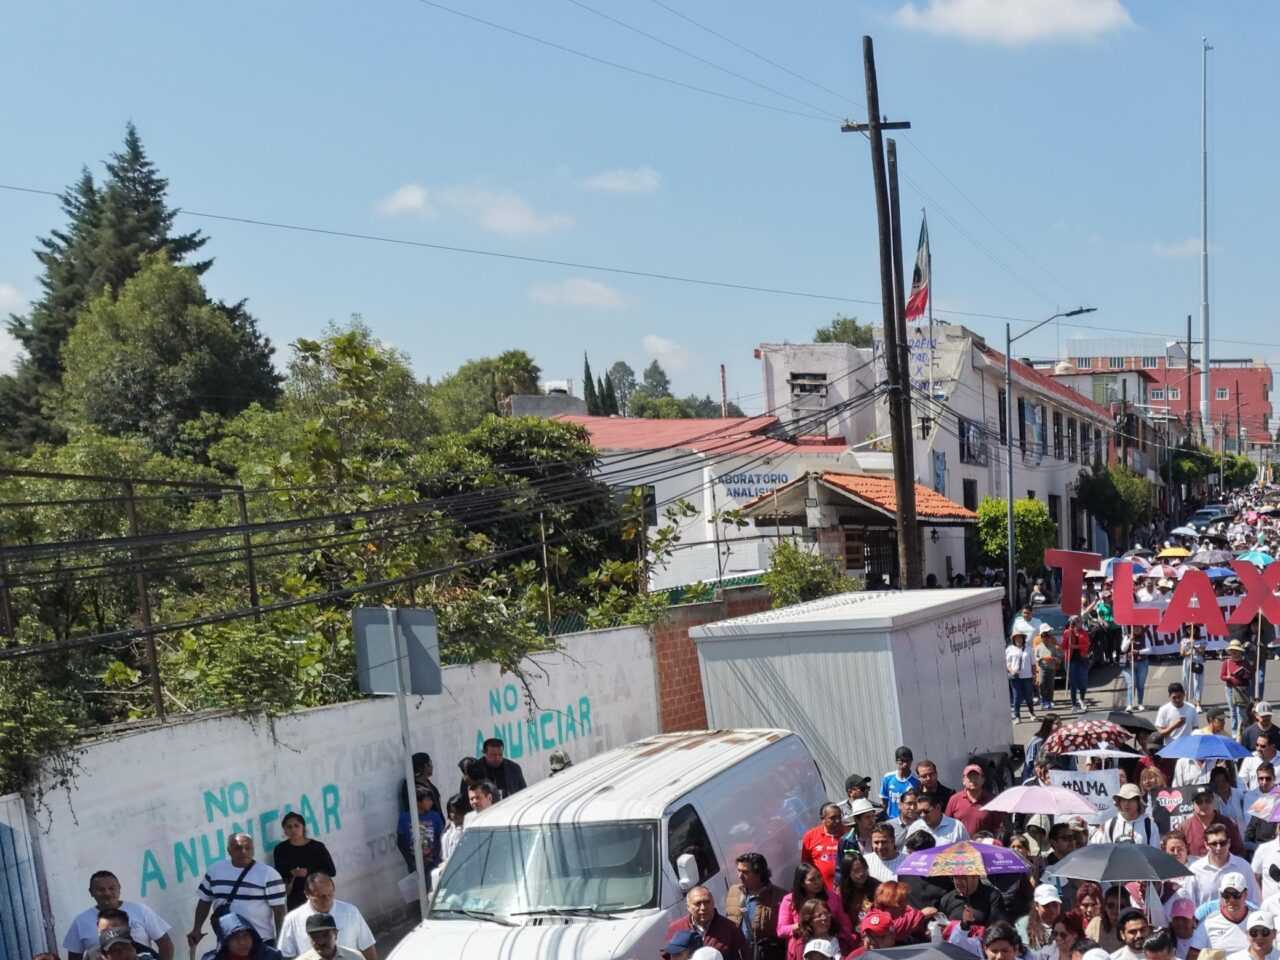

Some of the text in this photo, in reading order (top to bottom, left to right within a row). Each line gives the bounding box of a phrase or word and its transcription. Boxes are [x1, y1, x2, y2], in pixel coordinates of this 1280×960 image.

[714, 473, 788, 485] ABORATORIO
[489, 683, 518, 716] NO
[203, 781, 250, 823] NO
[1061, 779, 1108, 797] #ALMA
[140, 784, 341, 898] ANUCAR
